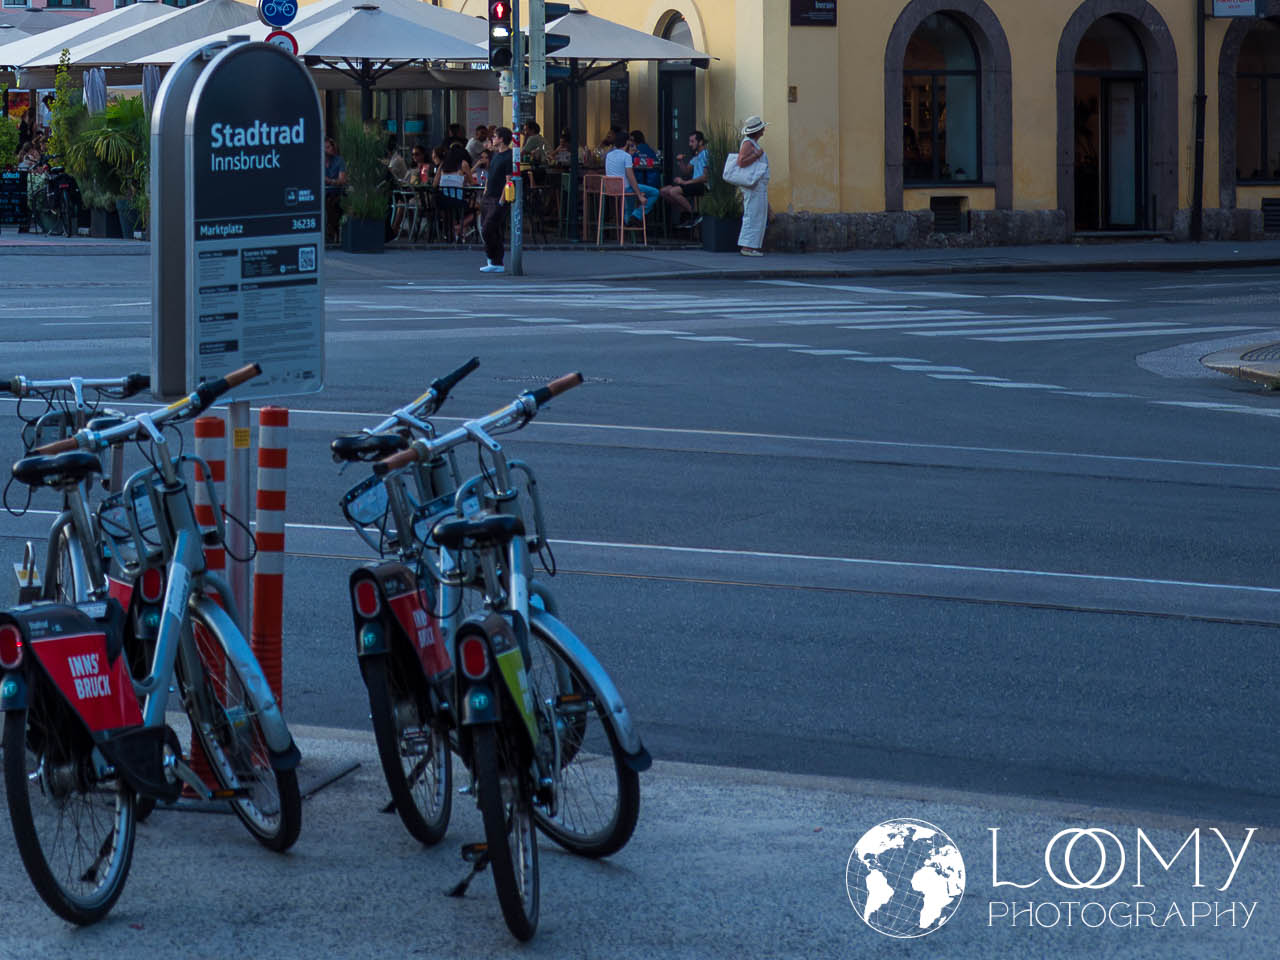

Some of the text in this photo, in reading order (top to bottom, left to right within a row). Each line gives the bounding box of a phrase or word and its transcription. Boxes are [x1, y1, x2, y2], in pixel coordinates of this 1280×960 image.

[210, 117, 305, 149] Stadtrad
[211, 149, 281, 171] Innsbruck
[200, 223, 244, 237] Marktplatz
[68, 653, 100, 677] INNS'
[73, 674, 112, 700] BRUCK
